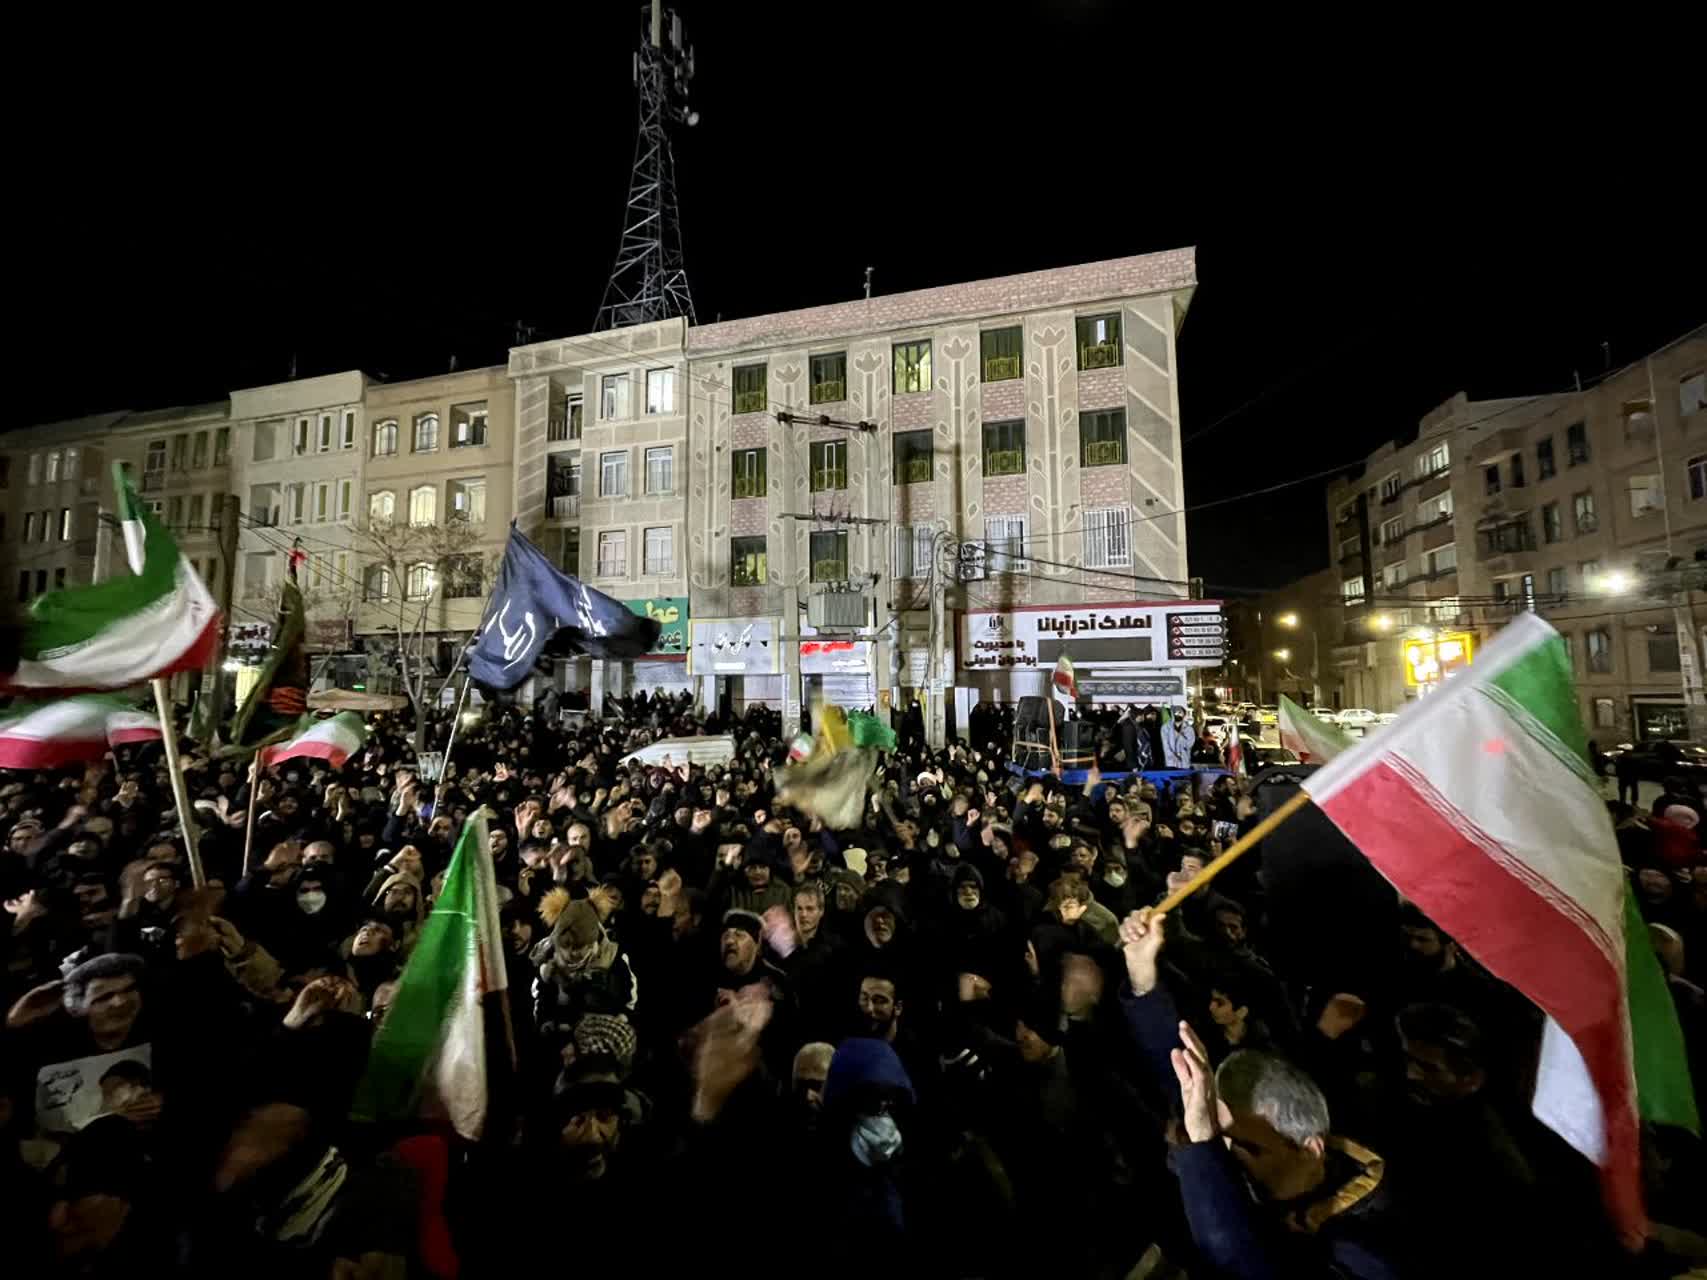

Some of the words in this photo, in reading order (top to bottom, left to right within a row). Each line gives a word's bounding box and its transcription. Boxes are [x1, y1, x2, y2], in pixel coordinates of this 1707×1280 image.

[1098, 614, 1153, 630] املاک
[974, 640, 1014, 652] مدیریت
[1015, 640, 1025, 651] با
[964, 654, 996, 667] امینی
[997, 655, 1037, 667] برادران
